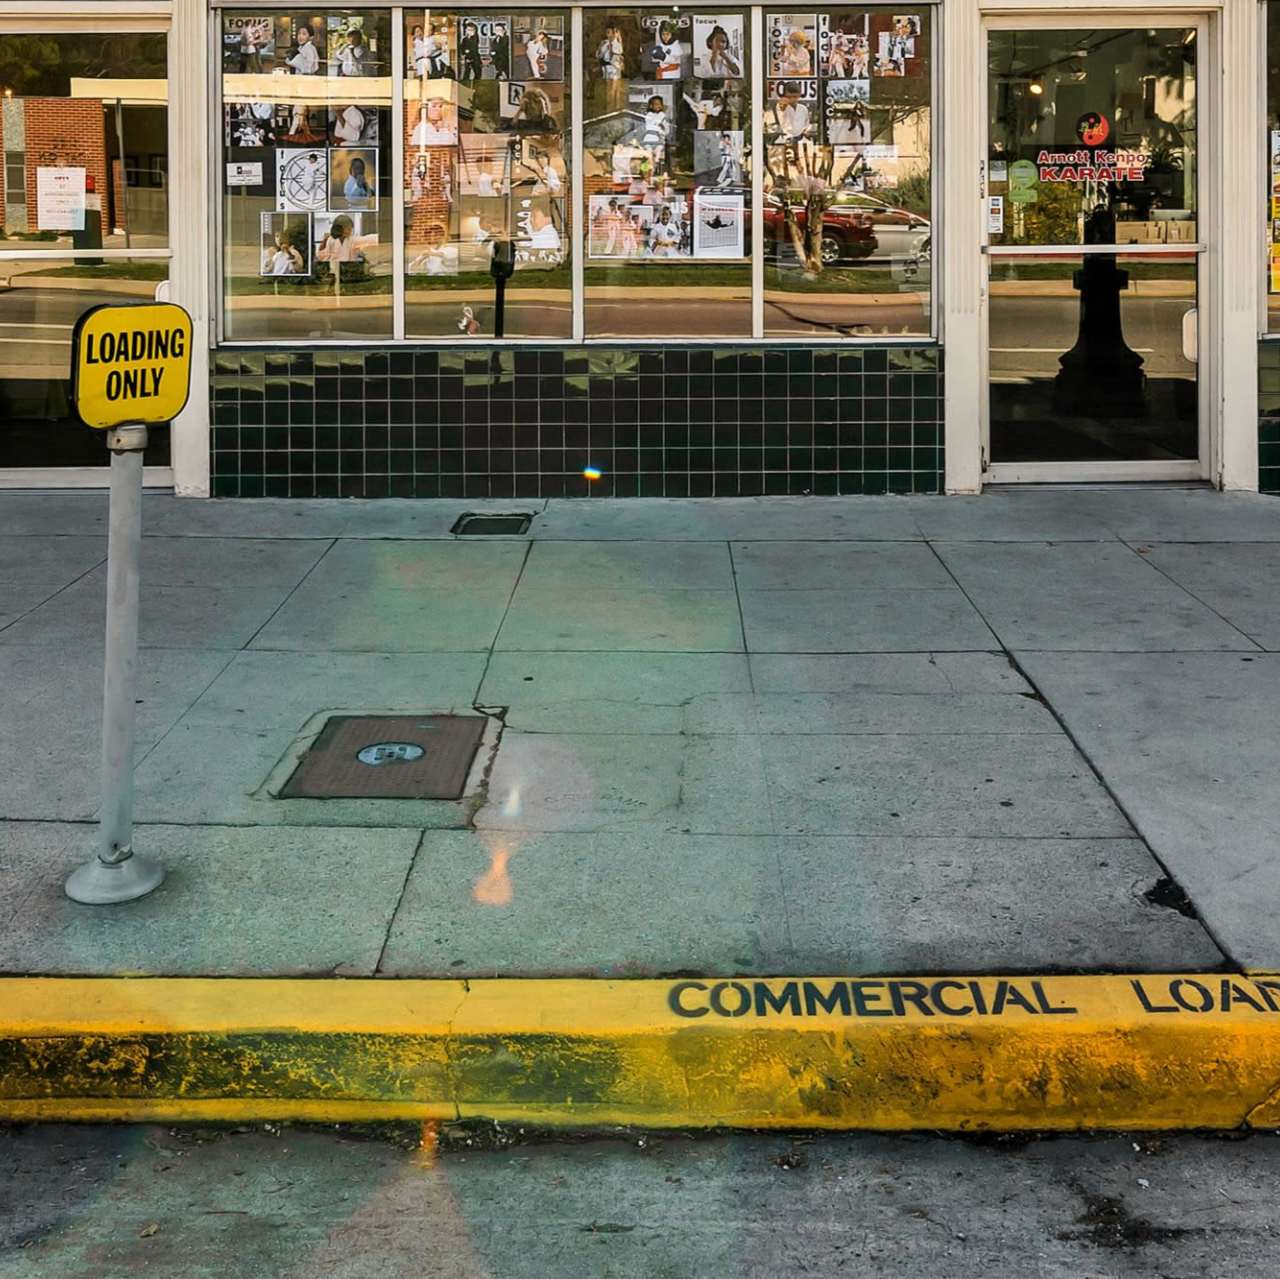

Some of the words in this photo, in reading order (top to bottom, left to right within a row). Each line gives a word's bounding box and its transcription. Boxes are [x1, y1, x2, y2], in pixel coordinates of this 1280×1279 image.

[768, 81, 817, 97] FOUS
[1037, 151, 1090, 164] Arnott
[1095, 151, 1147, 168] Kenpo
[1039, 167, 1145, 182] KARATE
[86, 328, 184, 364] LOADING
[106, 367, 164, 401] ONLY
[668, 980, 1077, 1018] COMMERCIAL
